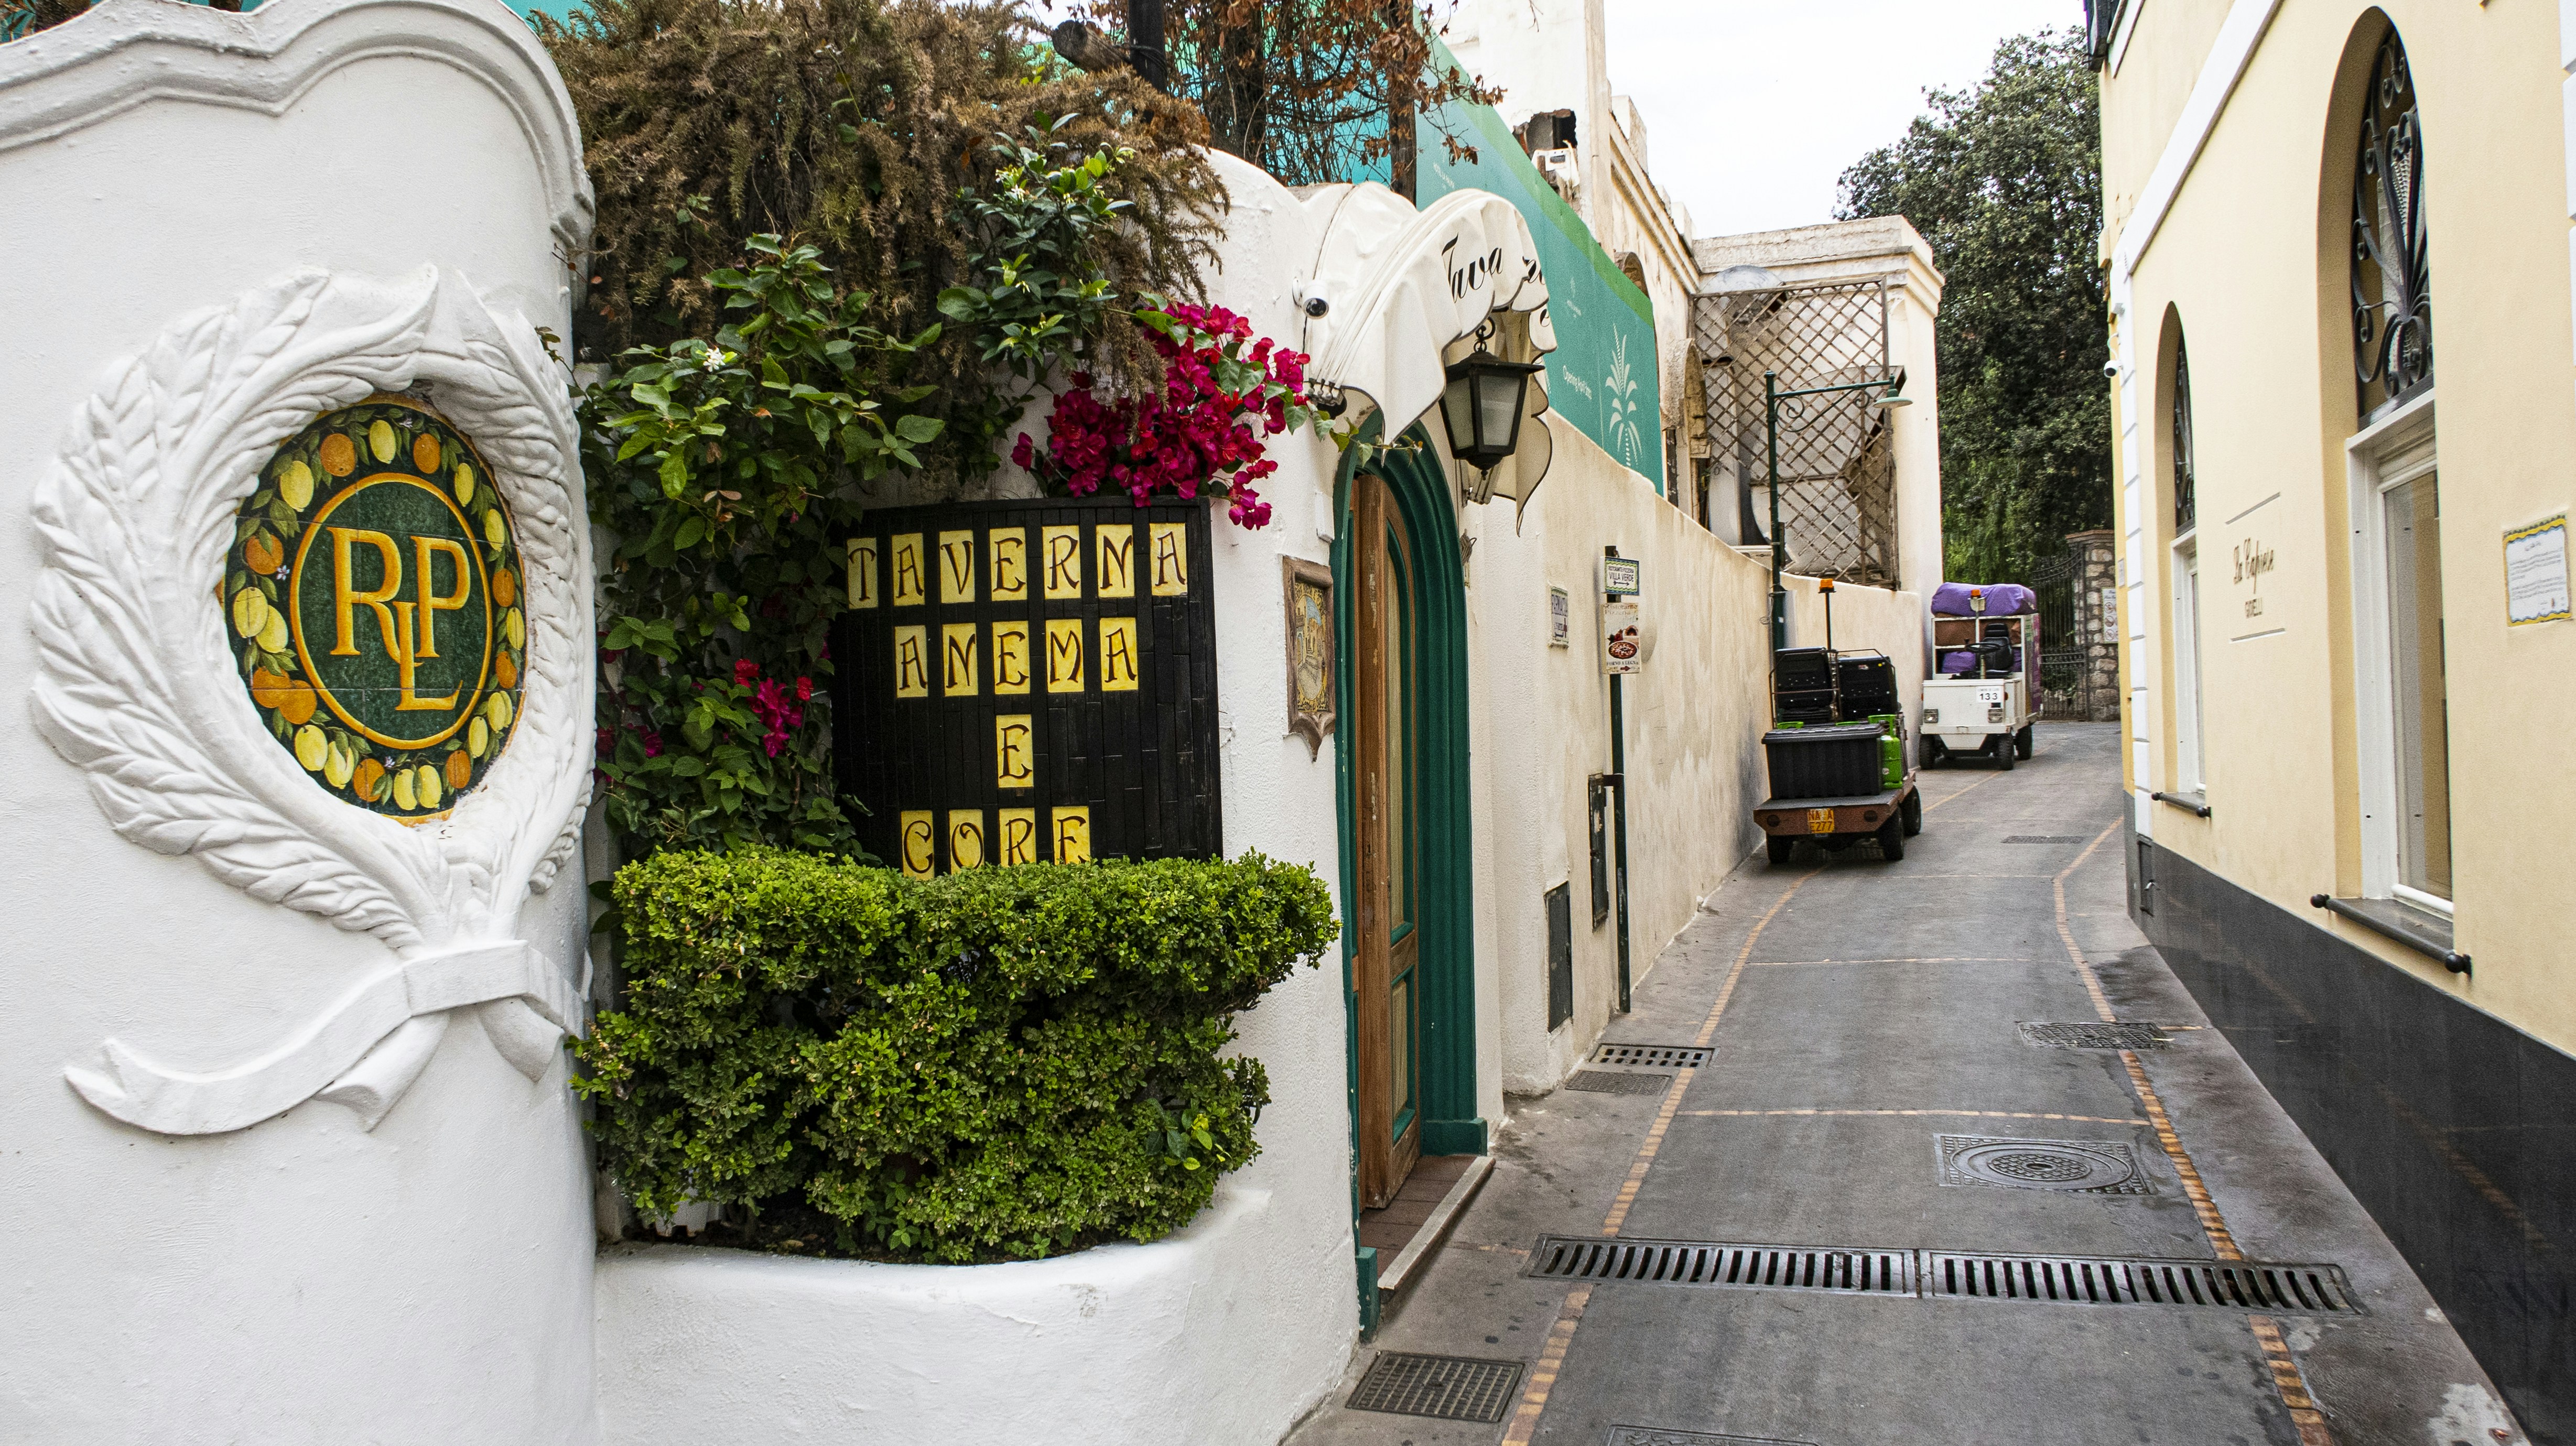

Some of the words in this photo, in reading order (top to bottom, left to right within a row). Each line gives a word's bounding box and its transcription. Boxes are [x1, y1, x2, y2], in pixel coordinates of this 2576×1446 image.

[848, 530, 1187, 602] TAVERNA
[1608, 572, 1620, 580] VILLA
[1621, 573, 1634, 582] VERDE
[899, 627, 1138, 691] ANEMA
[999, 723, 1032, 780] E
[904, 815, 1090, 874] CORE
